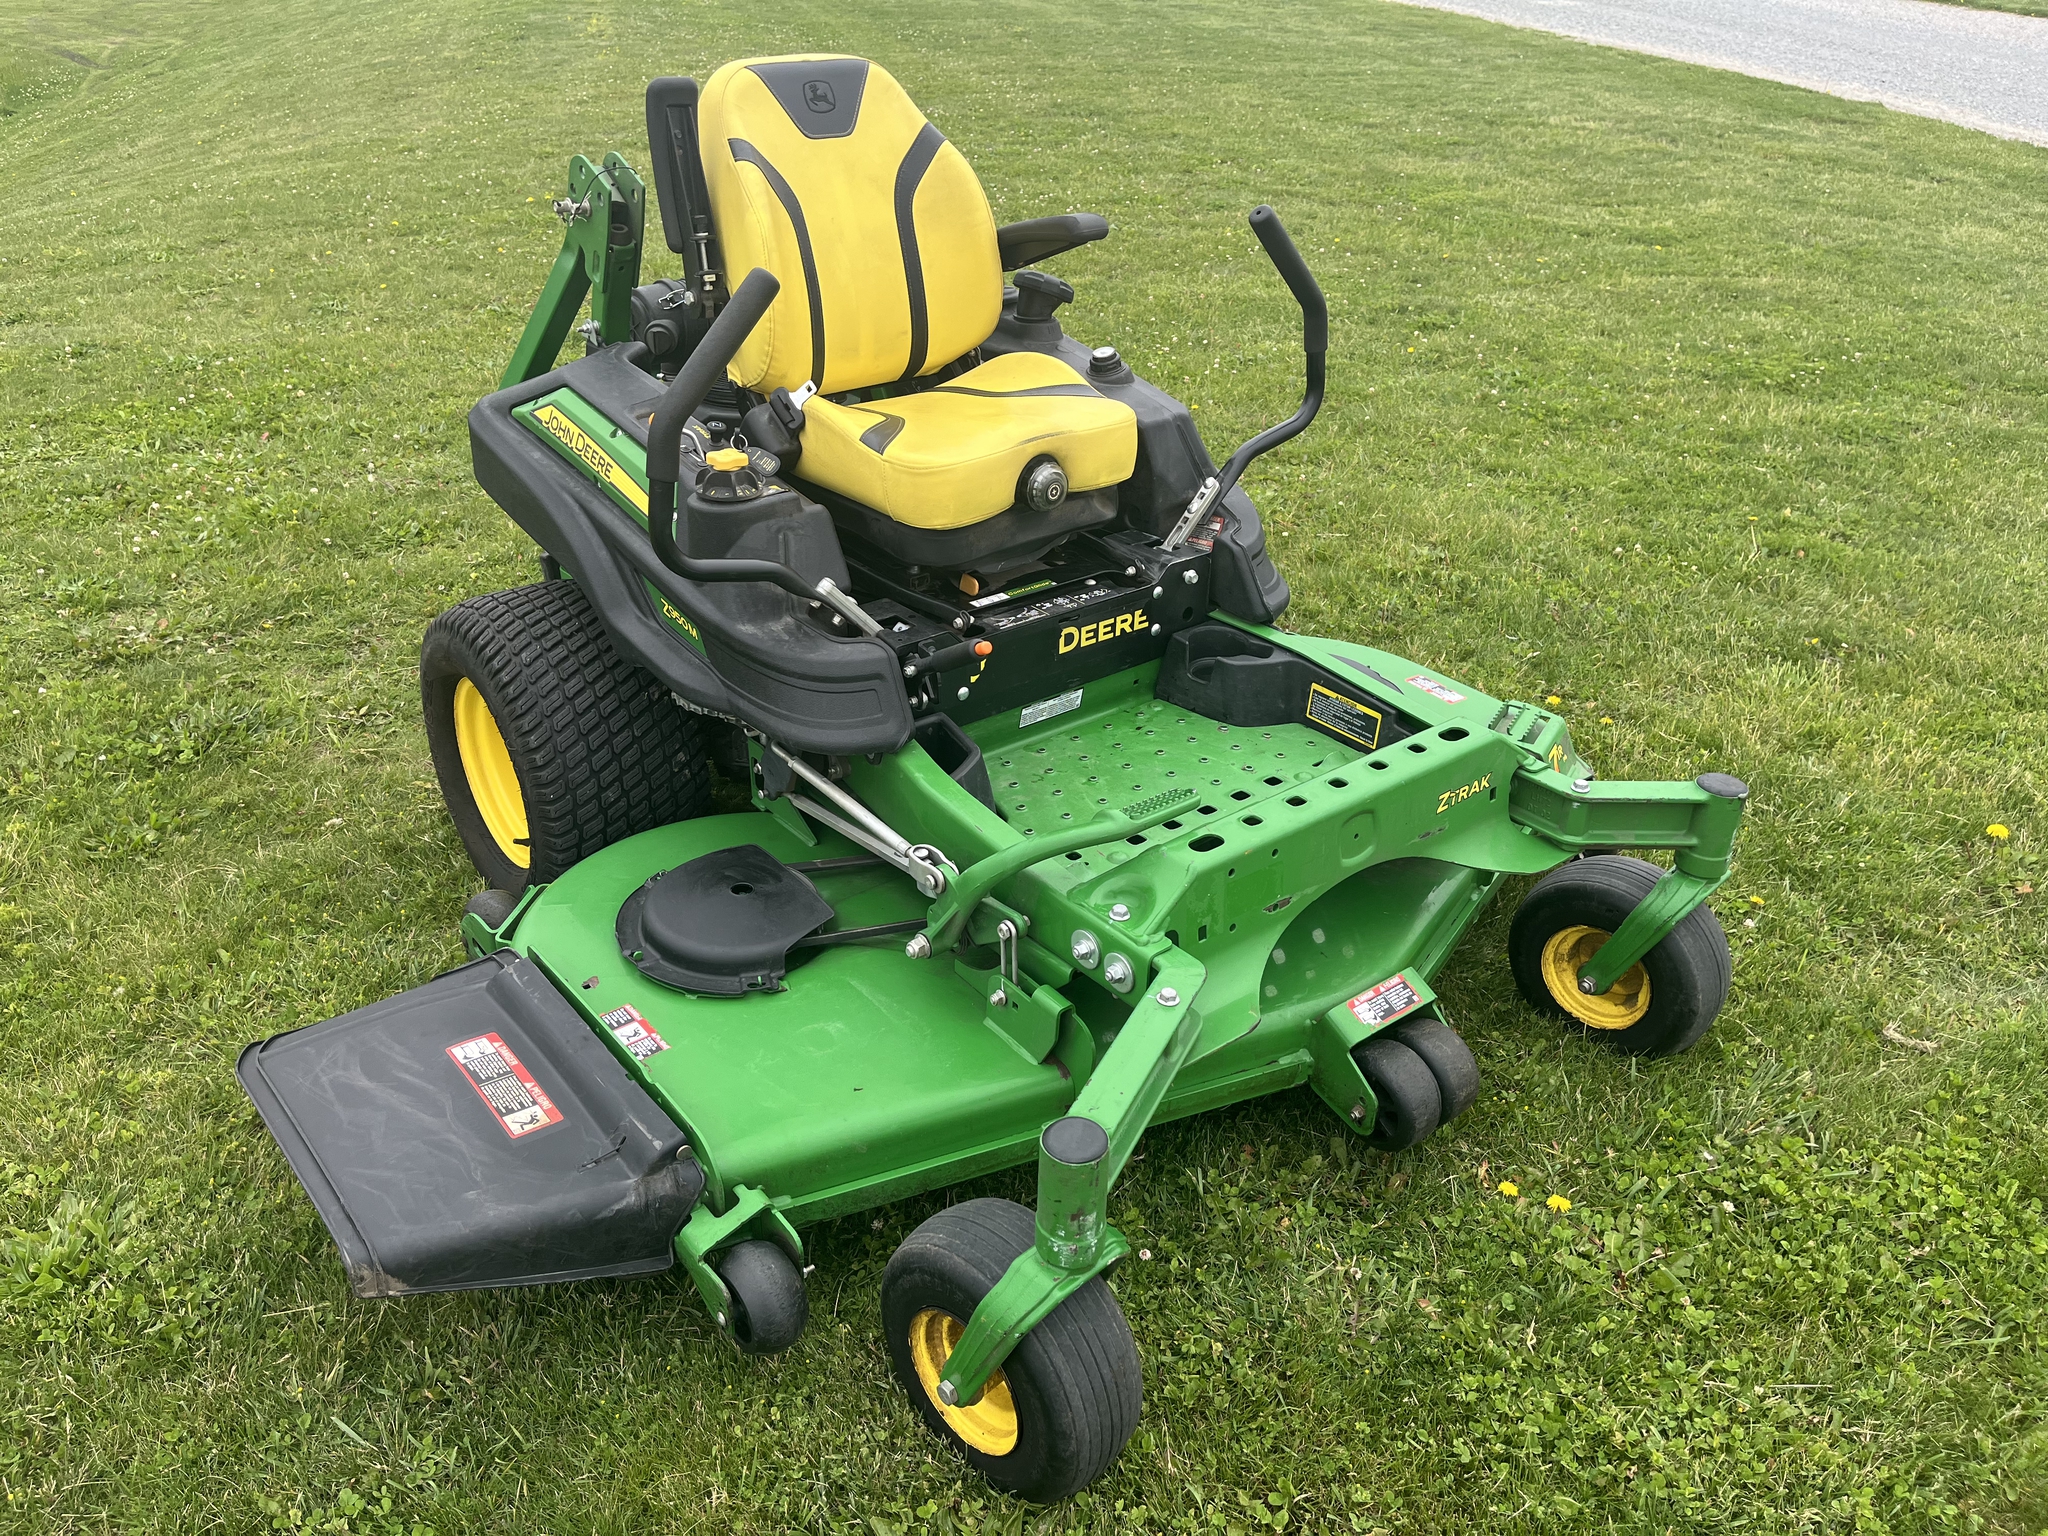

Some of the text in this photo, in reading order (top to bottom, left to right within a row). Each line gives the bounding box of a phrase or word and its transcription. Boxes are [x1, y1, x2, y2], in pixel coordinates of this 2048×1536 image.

[544, 410, 615, 480] JOHN DEERE
[660, 597, 699, 641] Z950M
[1058, 608, 1150, 655] DEERE
[1436, 771, 1493, 815] ZTRAK
[497, 1046, 519, 1066] DANGER
[530, 1086, 553, 1110] PELIGRO
